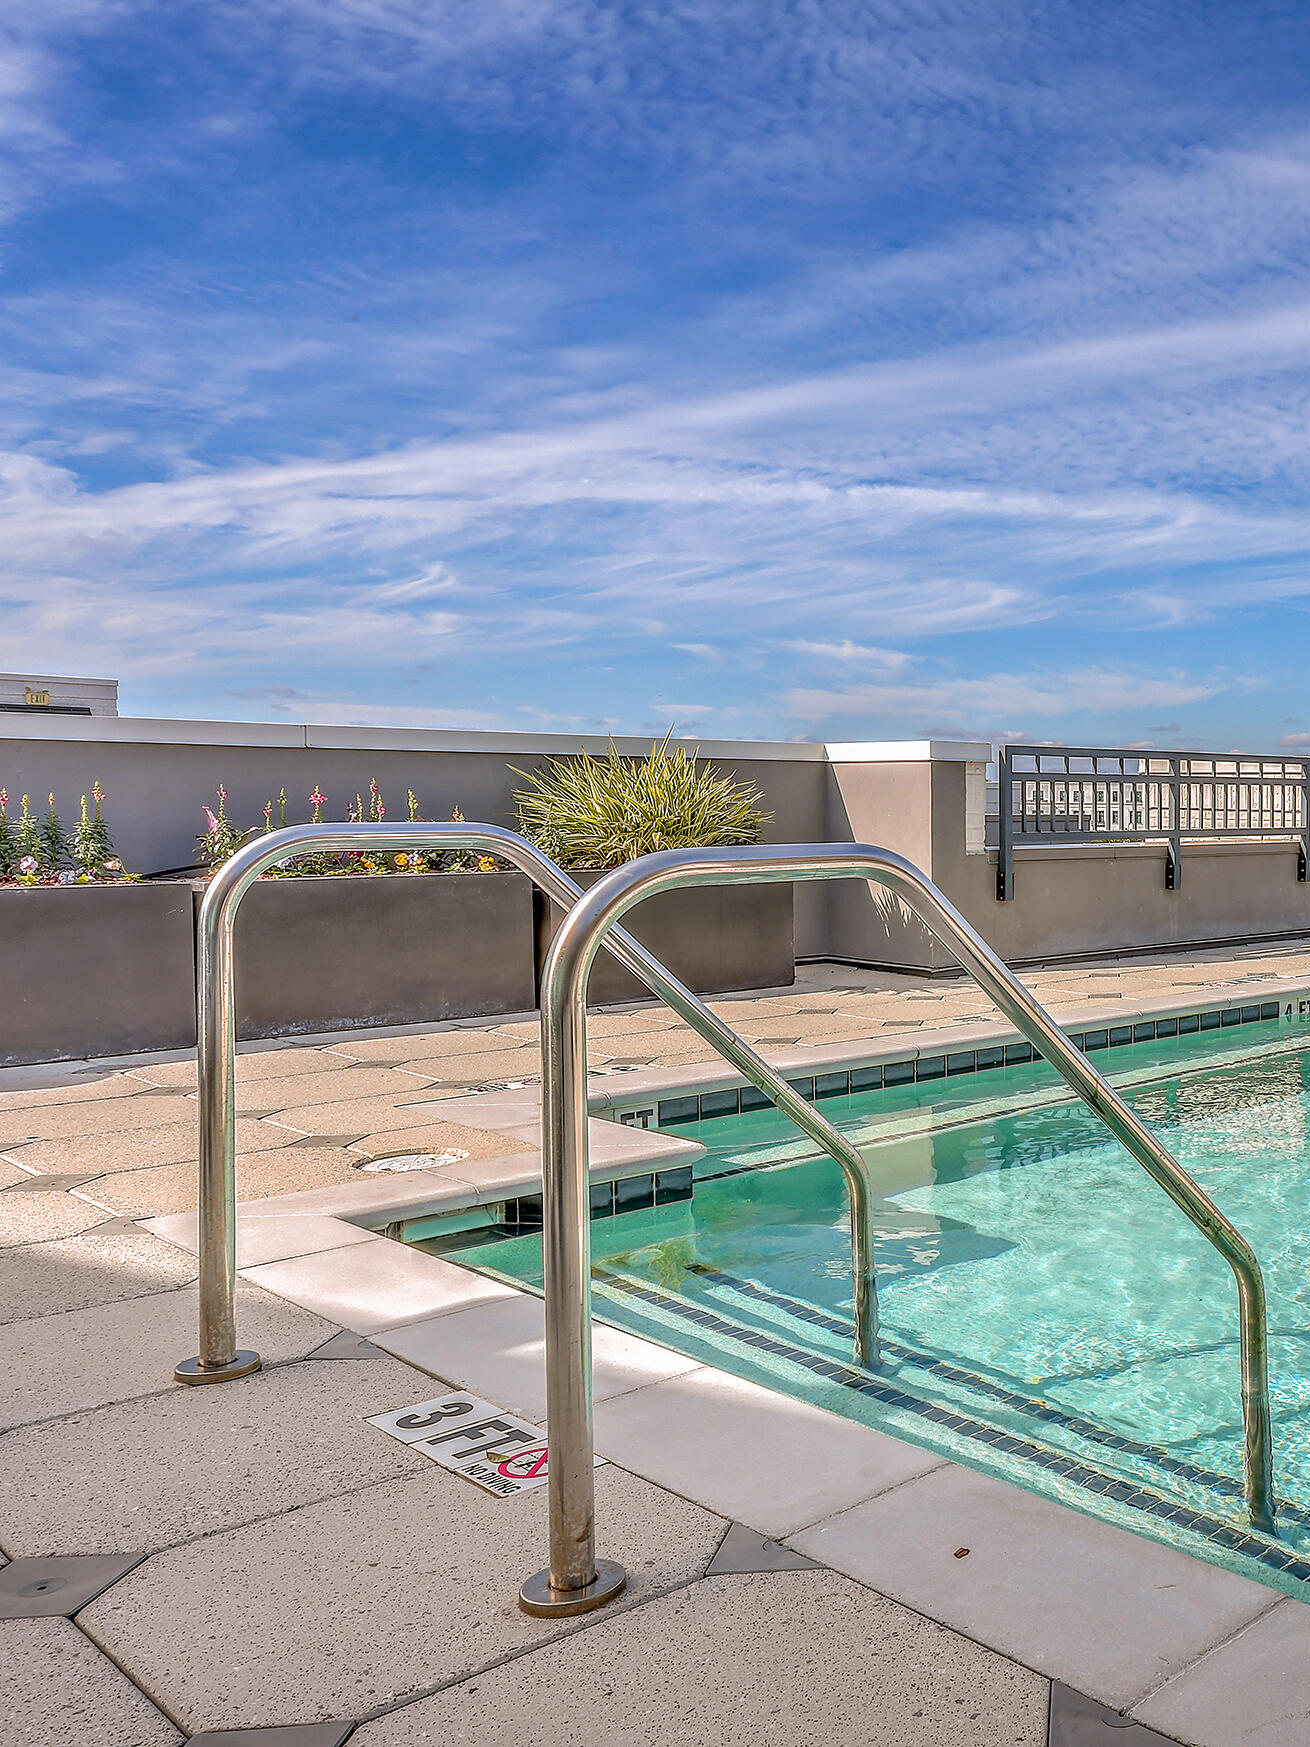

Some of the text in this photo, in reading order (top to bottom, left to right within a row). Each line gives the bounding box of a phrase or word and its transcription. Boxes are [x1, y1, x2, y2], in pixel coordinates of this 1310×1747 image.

[30, 694, 45, 704] EXIT
[1284, 1003, 1293, 1015] 4
[395, 1402, 538, 1460] 3 FT
[461, 1463, 522, 1494] NO DIVING
